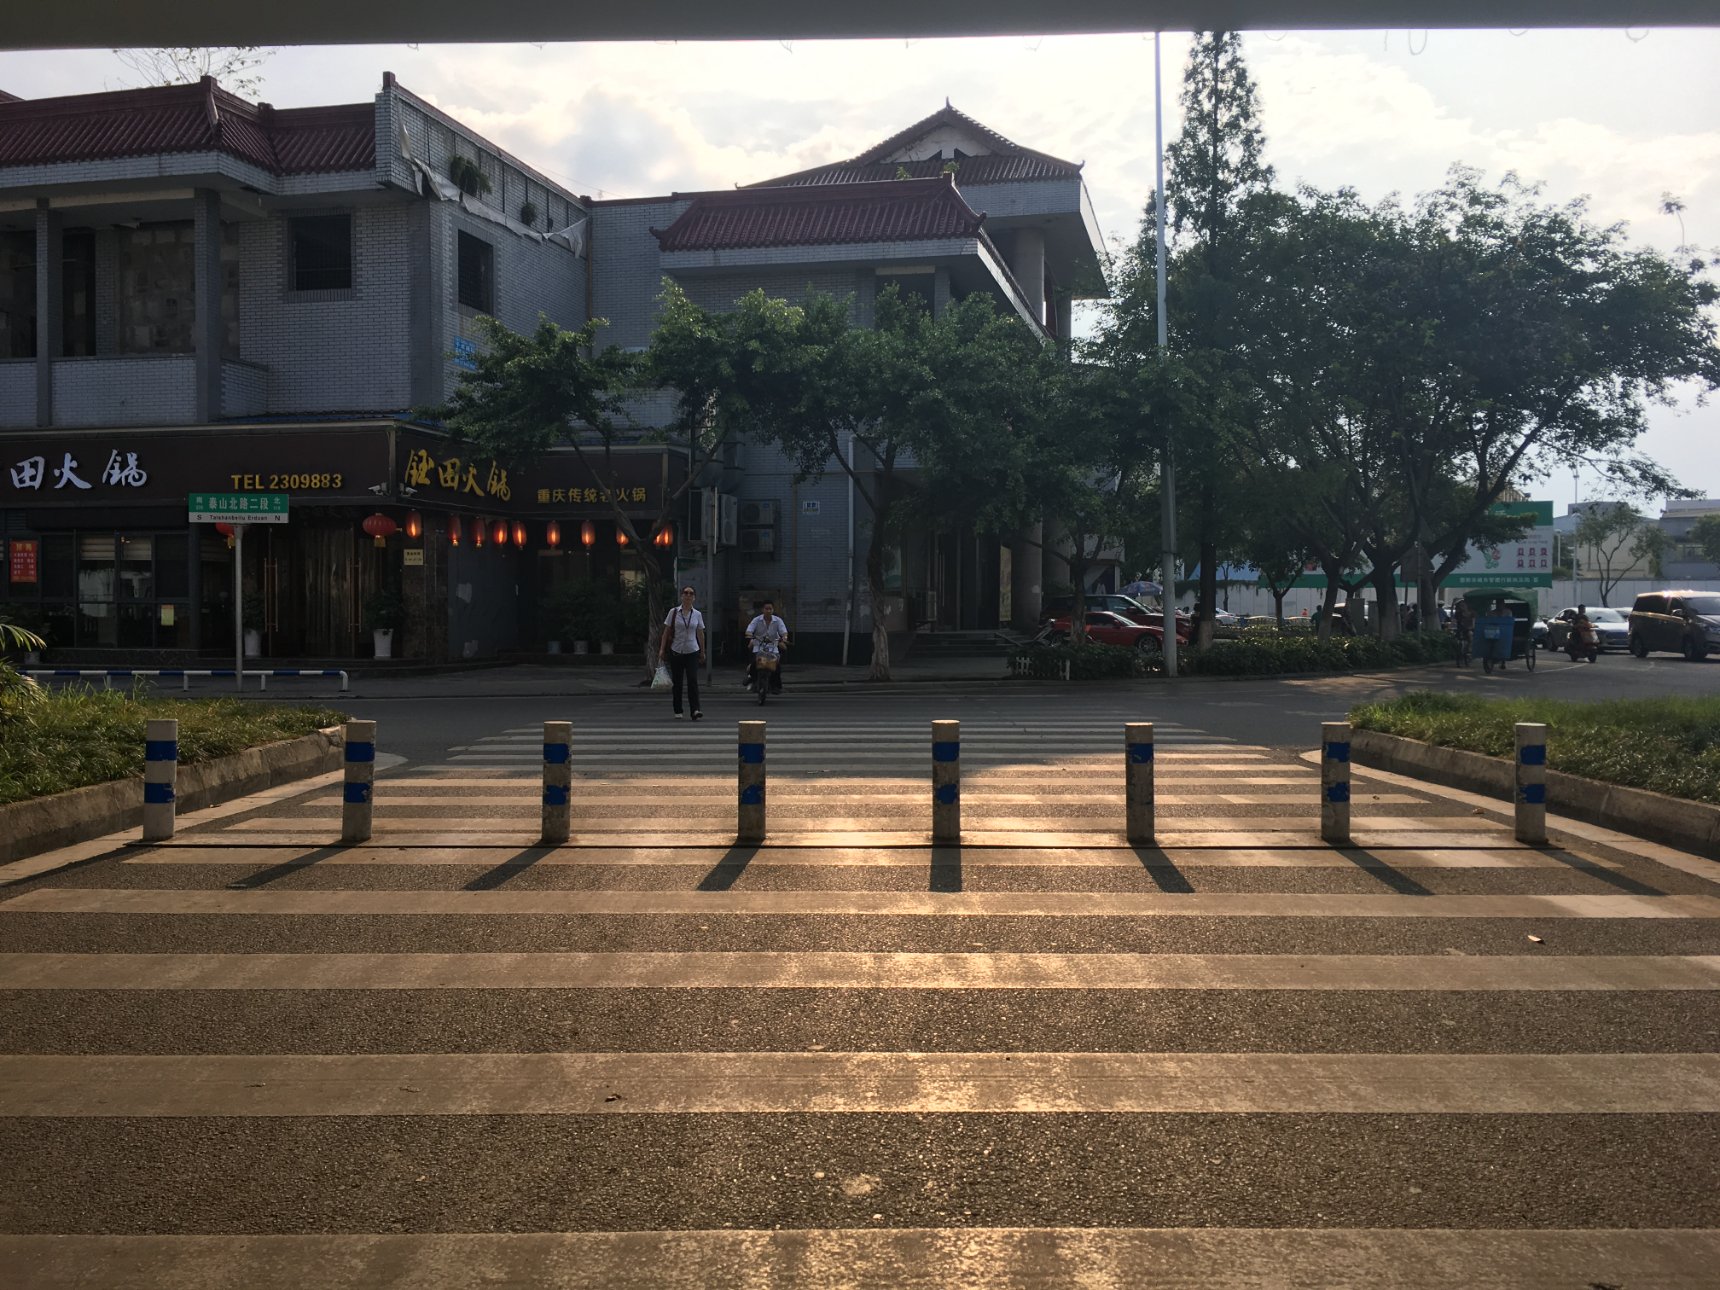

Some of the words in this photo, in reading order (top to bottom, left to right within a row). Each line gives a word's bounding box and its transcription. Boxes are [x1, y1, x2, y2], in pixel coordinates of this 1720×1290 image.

[231, 474, 265, 490] TEL
[269, 474, 342, 489] 2309883
[208, 496, 269, 510] 泰山北路二段
